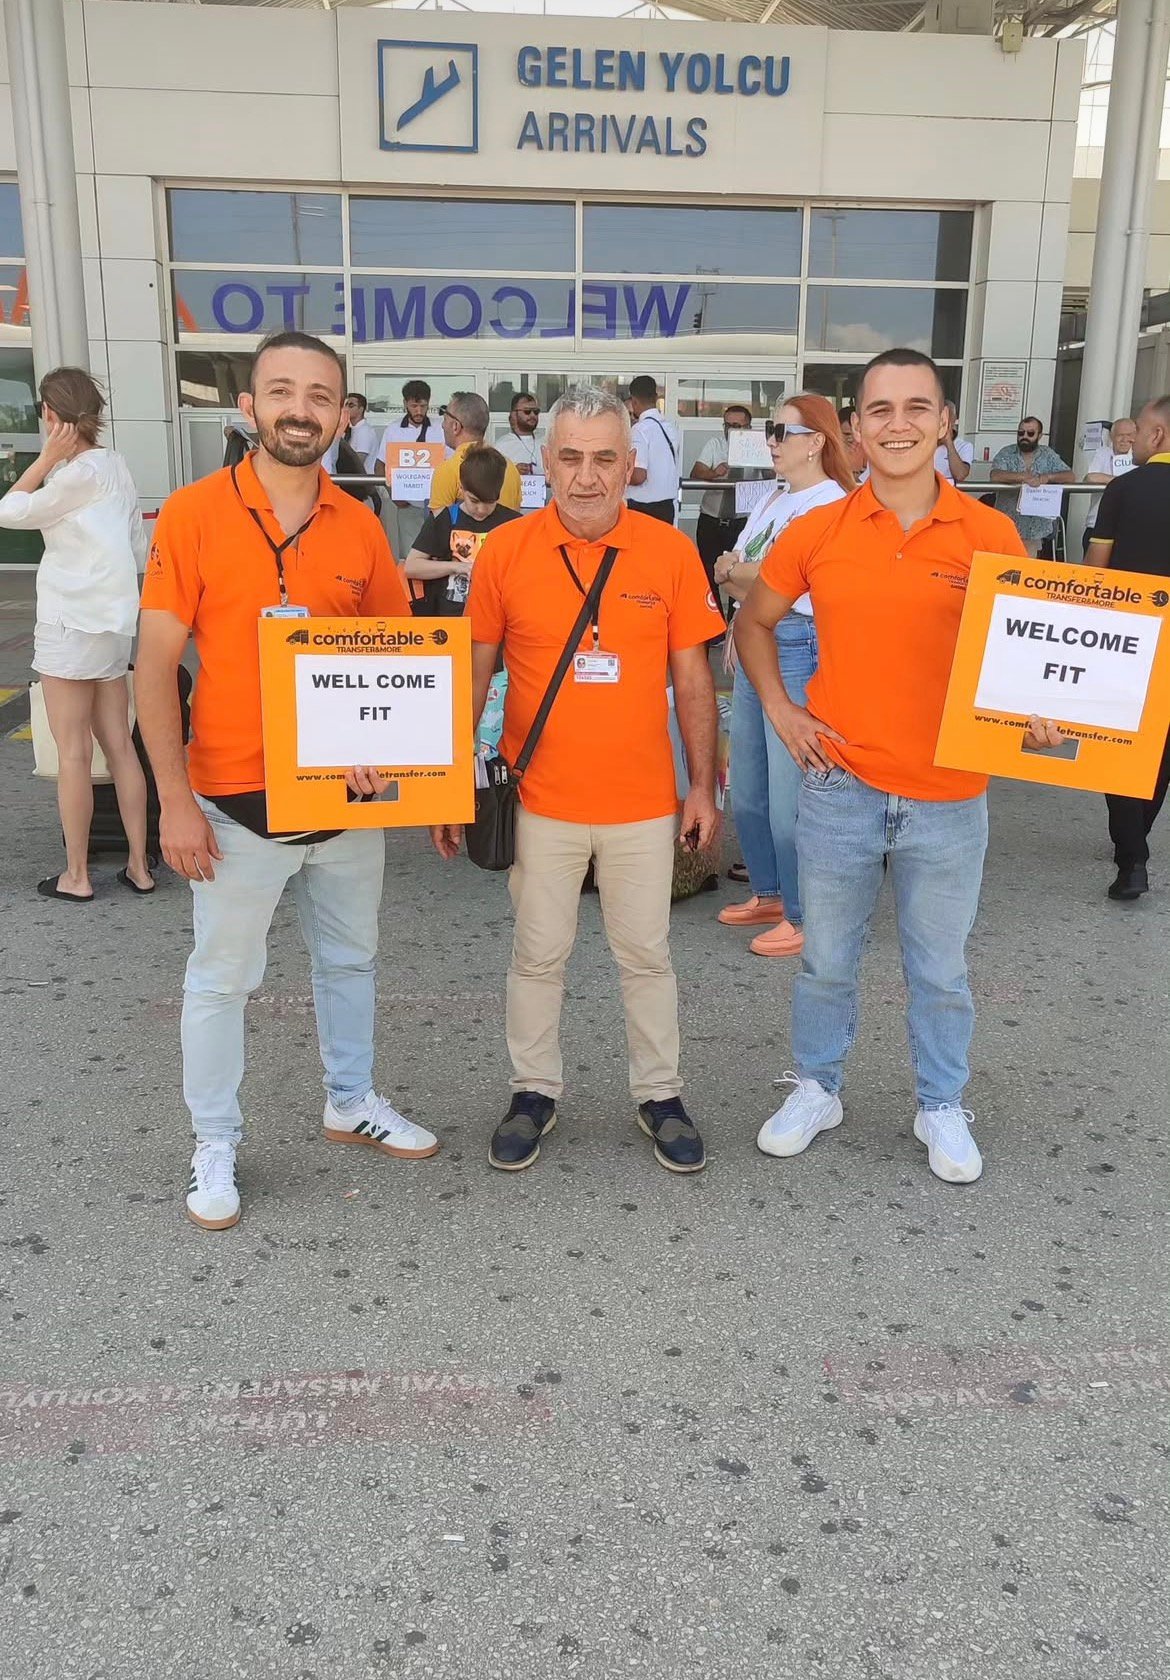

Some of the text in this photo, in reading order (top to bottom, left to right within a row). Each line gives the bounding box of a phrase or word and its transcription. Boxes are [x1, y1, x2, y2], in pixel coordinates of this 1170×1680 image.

[517, 45, 791, 96] GELEN YOLCU
[516, 110, 708, 157] ARRIVALS
[399, 449, 431, 467] B2
[1023, 576, 1142, 604] comfortable
[1046, 592, 1115, 609] TRANSFER&MORE
[312, 630, 424, 645] comfortable
[1006, 617, 1140, 655] WELCOME
[311, 674, 436, 689] WELL COME
[1043, 662, 1086, 685] FIT
[359, 706, 392, 721] FIT
[974, 714, 1133, 746] www.comfletransfer.com
[296, 769, 447, 781] www.comletransfer.com
